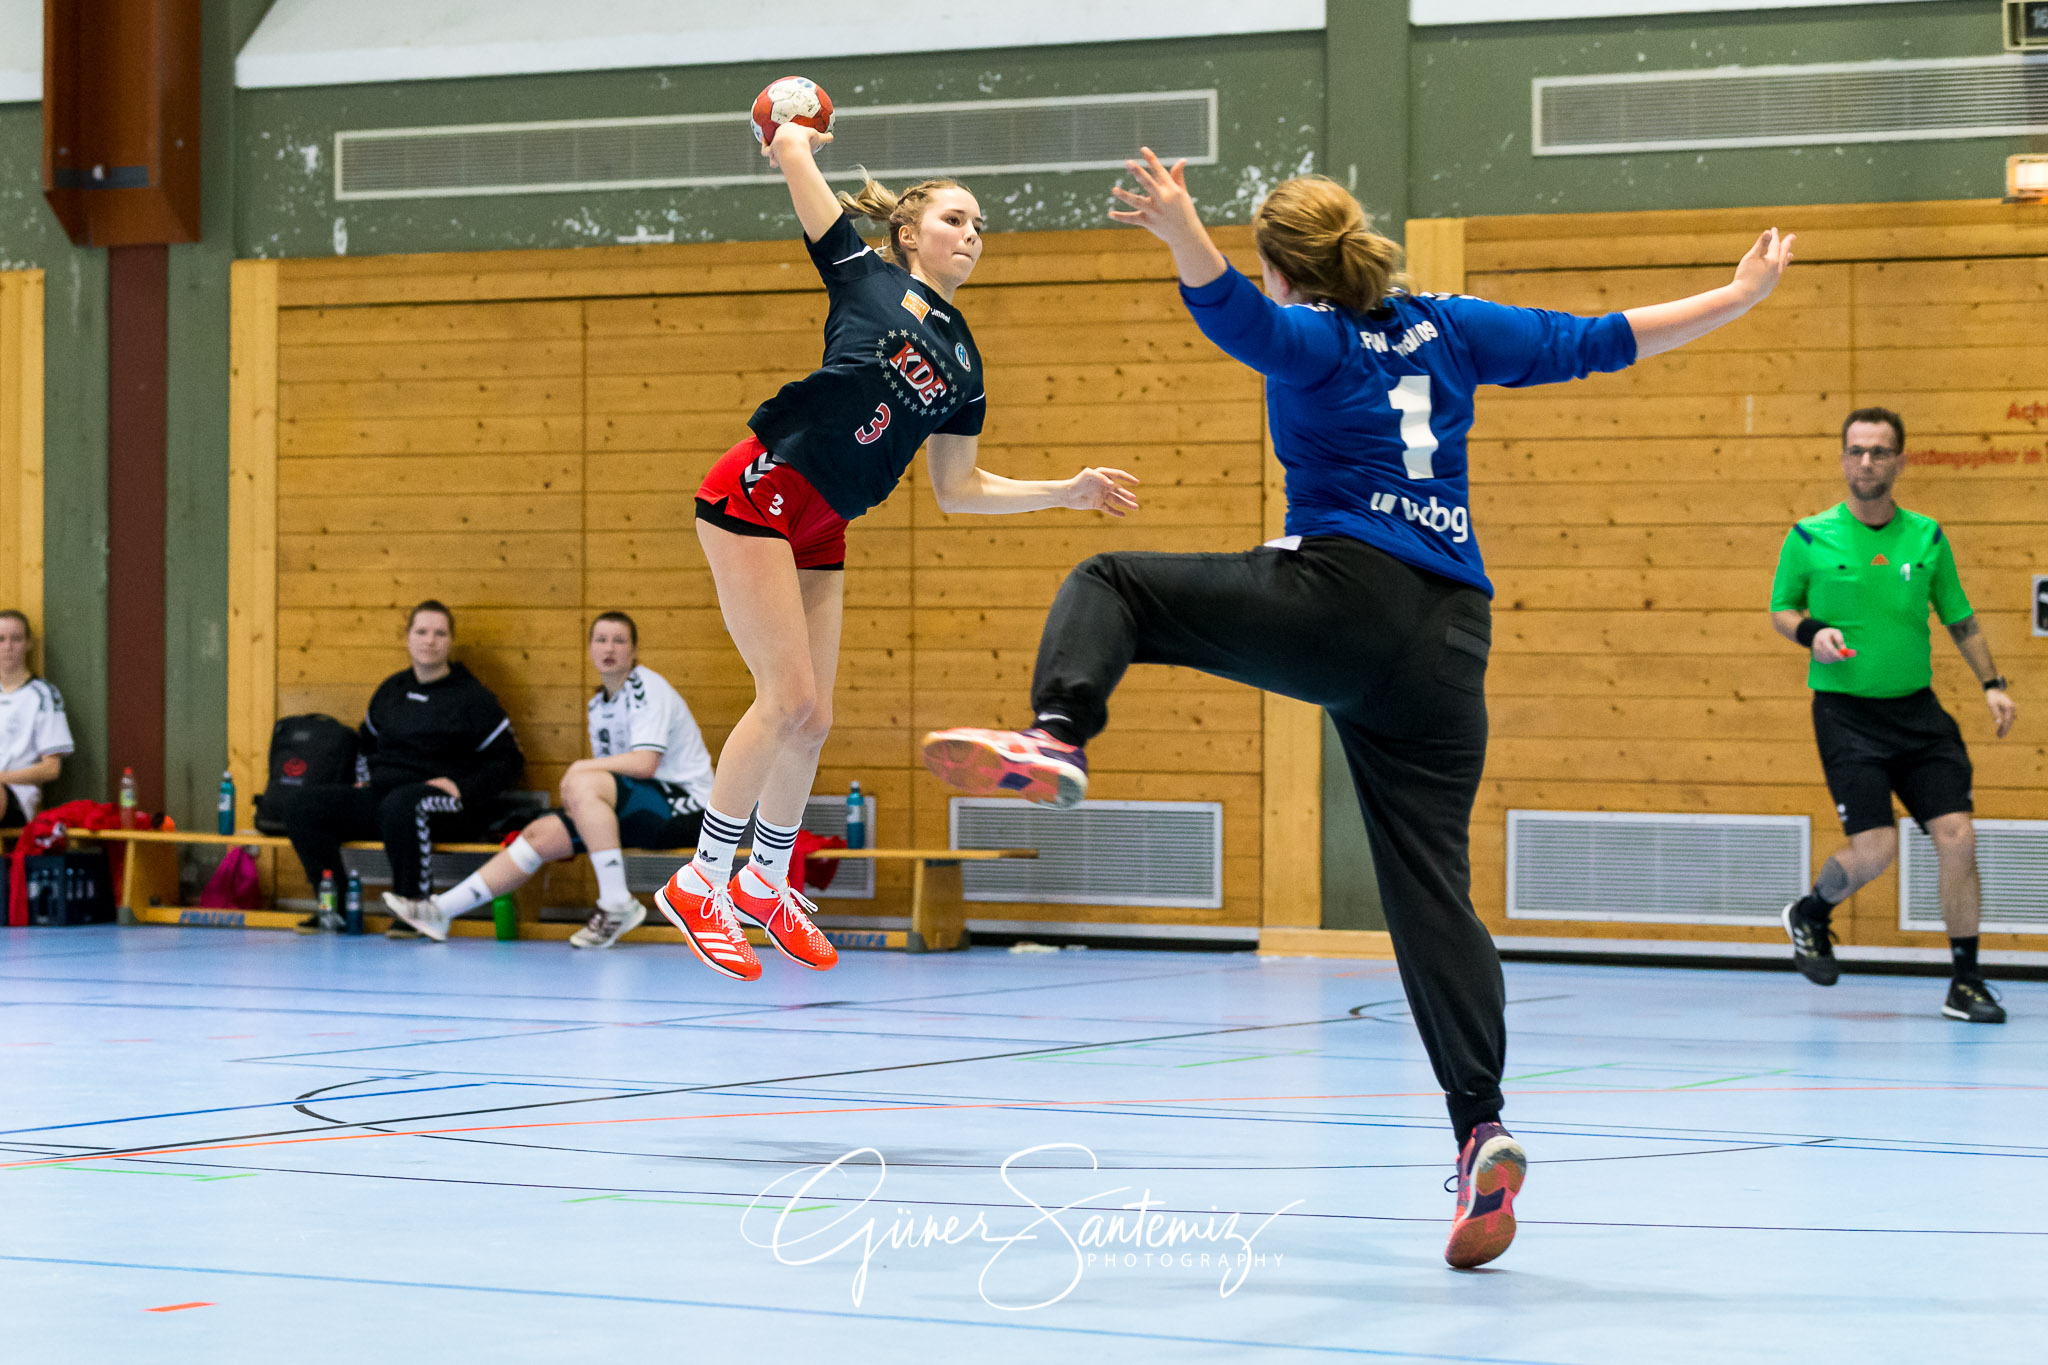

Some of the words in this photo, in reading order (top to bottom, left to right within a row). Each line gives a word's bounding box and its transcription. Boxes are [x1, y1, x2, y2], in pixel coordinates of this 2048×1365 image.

[889, 341, 947, 406] KDE
[855, 403, 891, 444] 3
[1387, 375, 1439, 479] 1
[768, 493, 784, 516] 3
